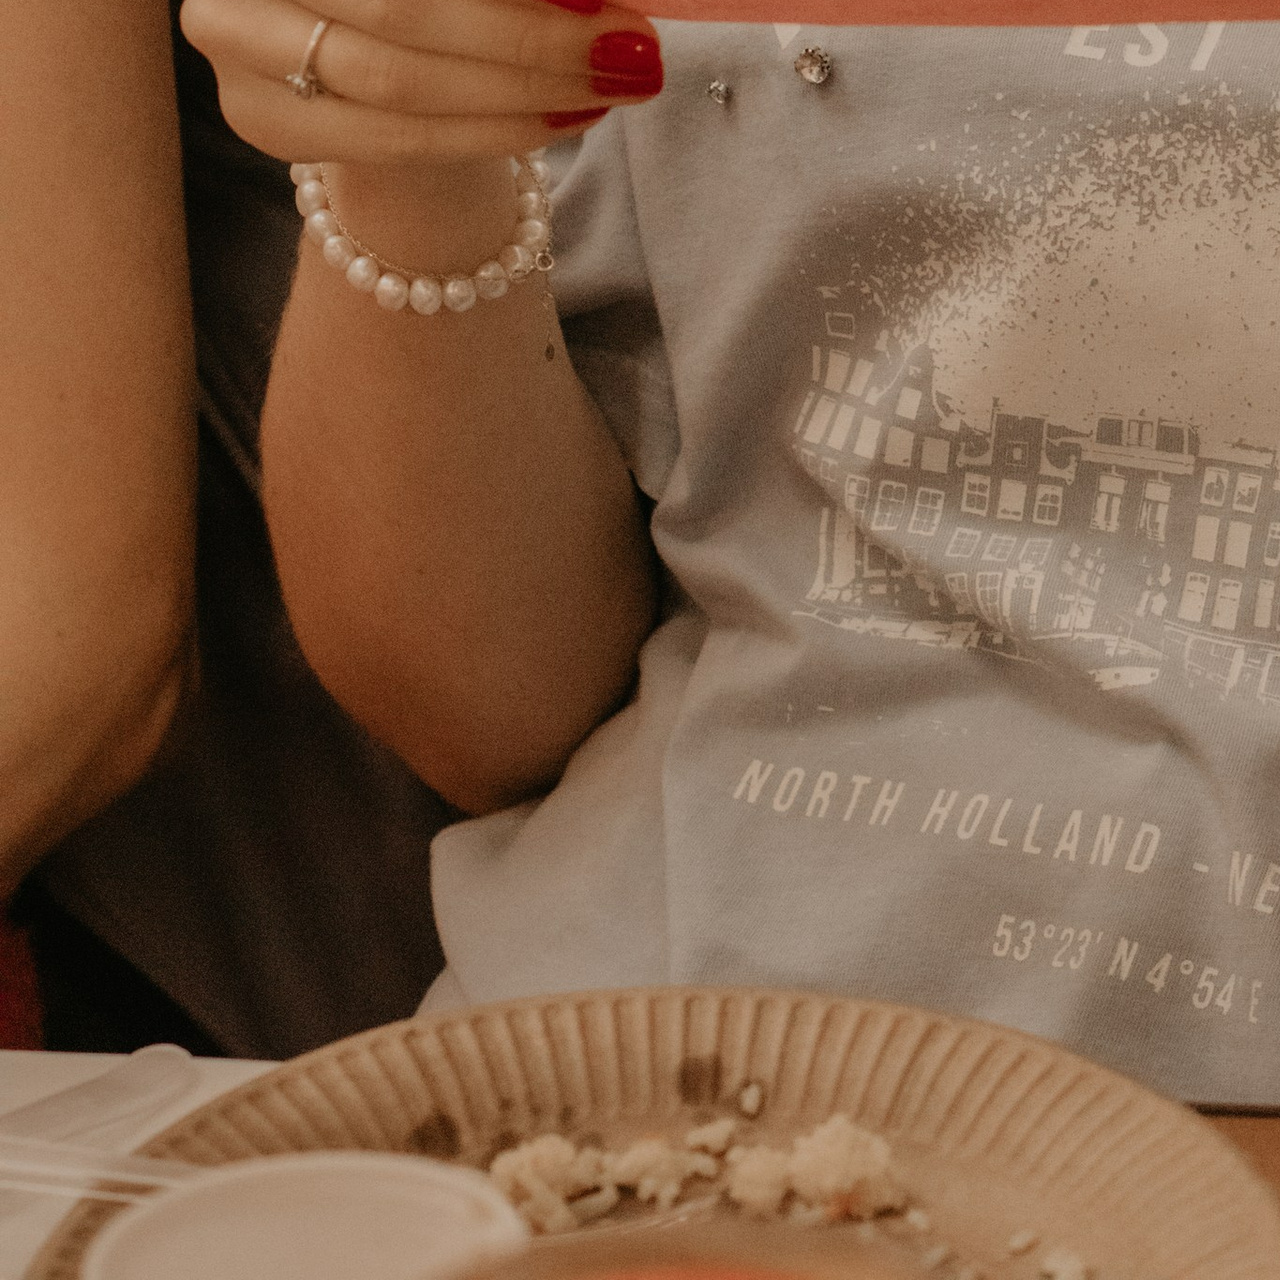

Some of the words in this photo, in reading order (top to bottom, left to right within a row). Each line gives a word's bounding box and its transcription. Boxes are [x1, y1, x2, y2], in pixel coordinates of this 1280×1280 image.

[733, 759, 905, 827] NORTH
[920, 788, 1161, 874] HOLLAND
[1108, 937, 1139, 981] N
